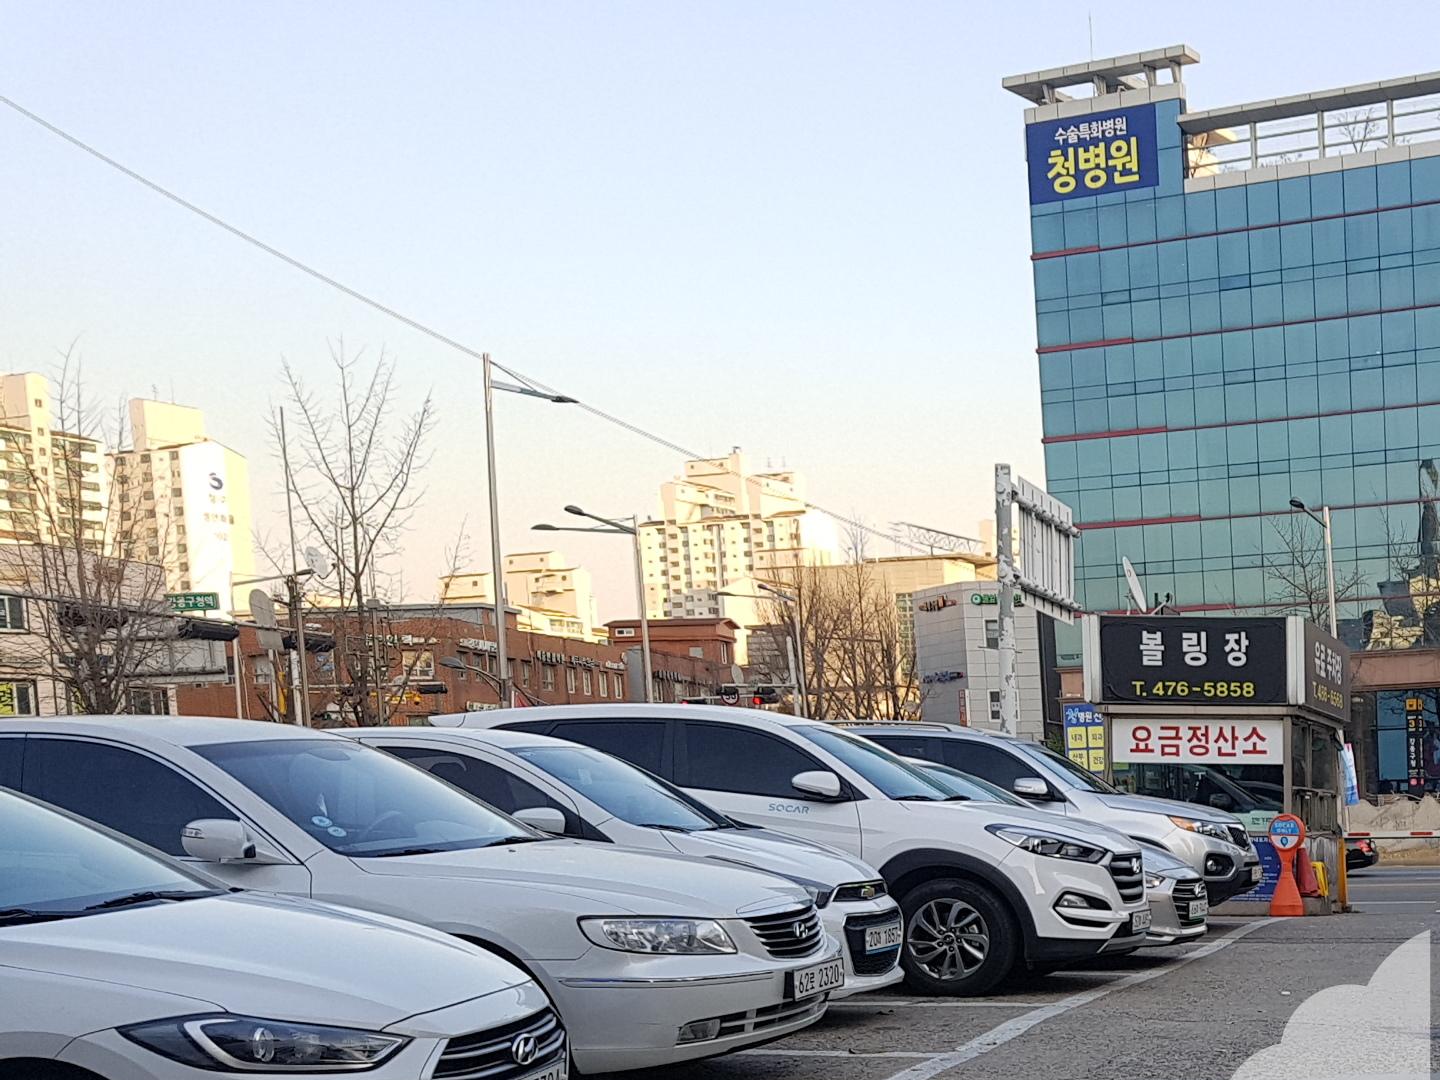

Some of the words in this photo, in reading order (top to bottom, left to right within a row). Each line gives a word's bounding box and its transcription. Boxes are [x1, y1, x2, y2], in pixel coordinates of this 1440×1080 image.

[1054, 116, 1127, 145] 수술특화병원
[1047, 136, 1140, 194] 청병원
[1129, 725, 1268, 757] 요금정산소
[768, 803, 809, 814] SOCAR
[819, 964, 839, 987] 2320
